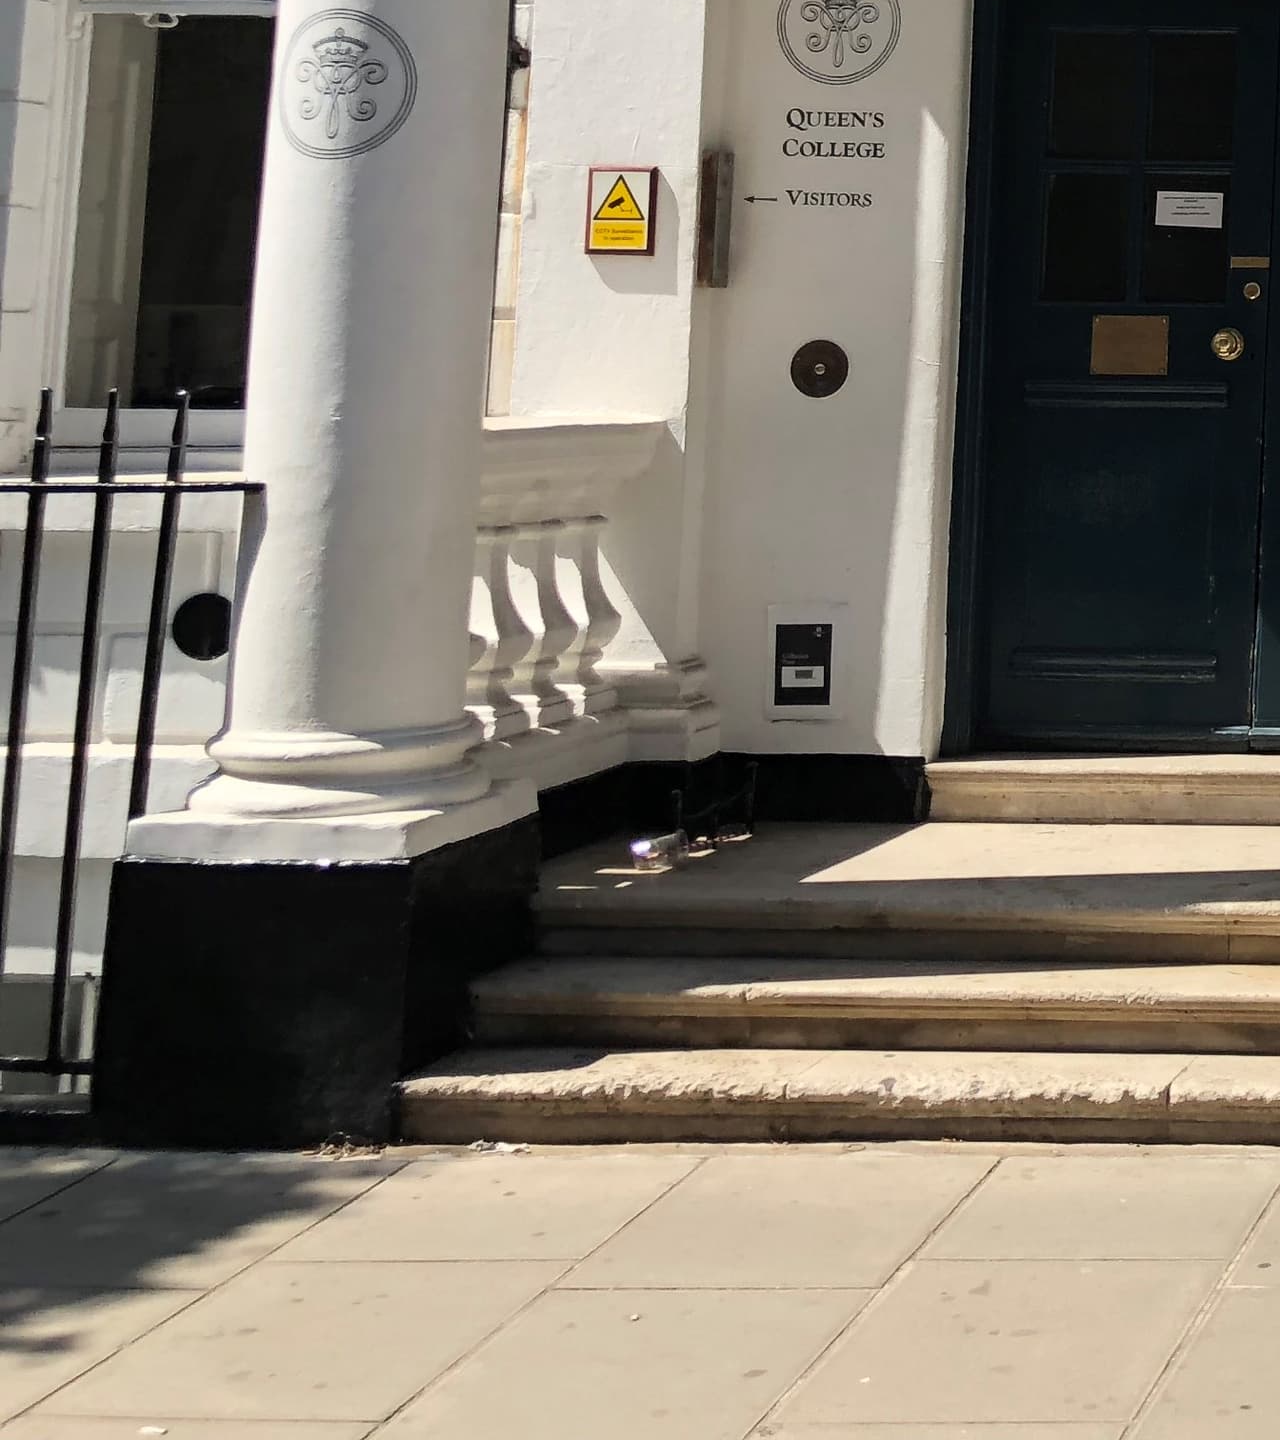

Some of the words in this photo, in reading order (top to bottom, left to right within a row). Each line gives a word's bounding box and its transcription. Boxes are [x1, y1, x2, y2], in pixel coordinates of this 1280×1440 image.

[786, 107, 886, 132] QUEEN'S
[782, 138, 886, 159] COLLEGE
[786, 189, 873, 209] VISITORS
